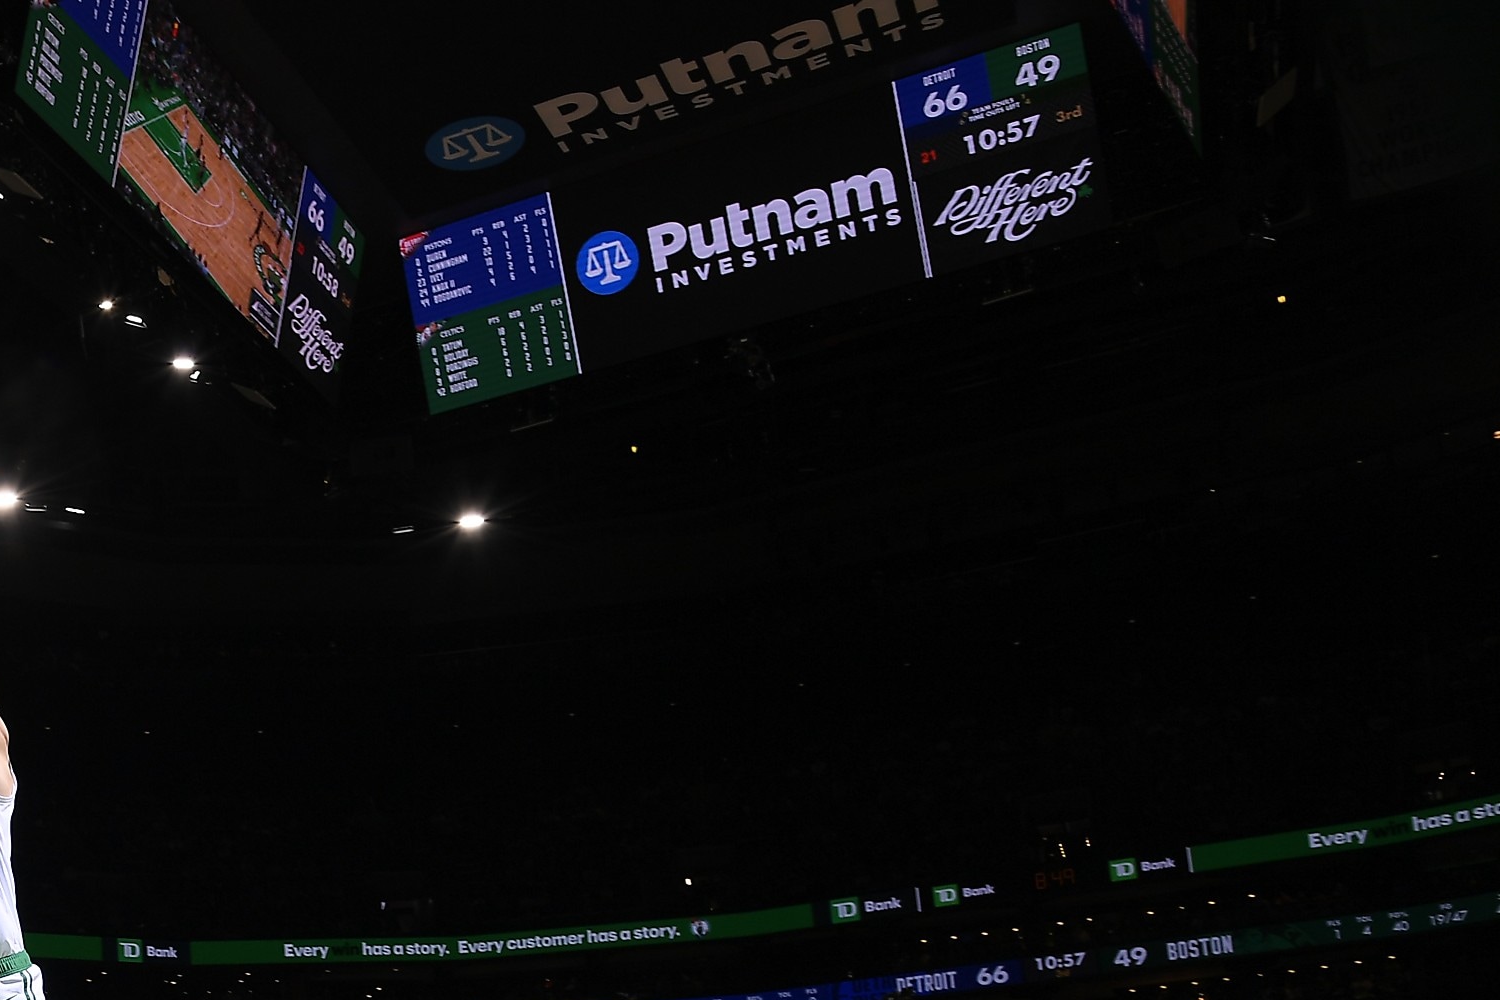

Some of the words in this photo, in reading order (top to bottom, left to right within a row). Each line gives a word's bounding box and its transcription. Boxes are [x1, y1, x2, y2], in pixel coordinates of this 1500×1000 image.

[1015, 38, 1050, 57] BOSTON
[533, 0, 939, 138] Putnam
[557, 13, 944, 153] INVESTMENTS
[923, 67, 956, 87] DETROIT
[1015, 55, 1060, 86] 49
[923, 85, 967, 117] 66
[1056, 105, 1082, 122] 3rd
[963, 114, 1041, 154] 10:57
[921, 150, 937, 163] 21
[933, 157, 1093, 235] Different
[308, 201, 324, 231] 66
[647, 167, 898, 273] Putnam
[985, 188, 1076, 243] Here
[338, 236, 355, 265] 49
[655, 209, 902, 293] INVESTMENTS
[311, 256, 338, 298] 10:58
[288, 294, 344, 359] Different
[299, 338, 335, 373] Here
[1308, 829, 1368, 849] Every
[1411, 812, 1453, 832] has
[1454, 809, 1471, 823] a
[1111, 863, 1135, 878] TD
[1140, 857, 1176, 873] Bank
[833, 902, 857, 919] TD
[864, 897, 901, 913] Bank
[935, 889, 959, 904] TD
[962, 884, 995, 899] Bank
[119, 942, 140, 958] TD
[146, 945, 178, 958] Bank
[284, 943, 329, 959] Every
[362, 942, 389, 956] has
[390, 945, 403, 956] a
[404, 942, 450, 957] story.
[457, 940, 505, 955] Every
[508, 931, 585, 951] customer
[587, 929, 618, 944] has
[620, 931, 632, 941] a
[633, 925, 681, 940] story.
[896, 971, 958, 993] DETROIT
[975, 965, 1010, 986] 66
[1035, 952, 1087, 971] 10:57
[1113, 946, 1149, 967] 49
[1166, 935, 1234, 961] BOSTON
